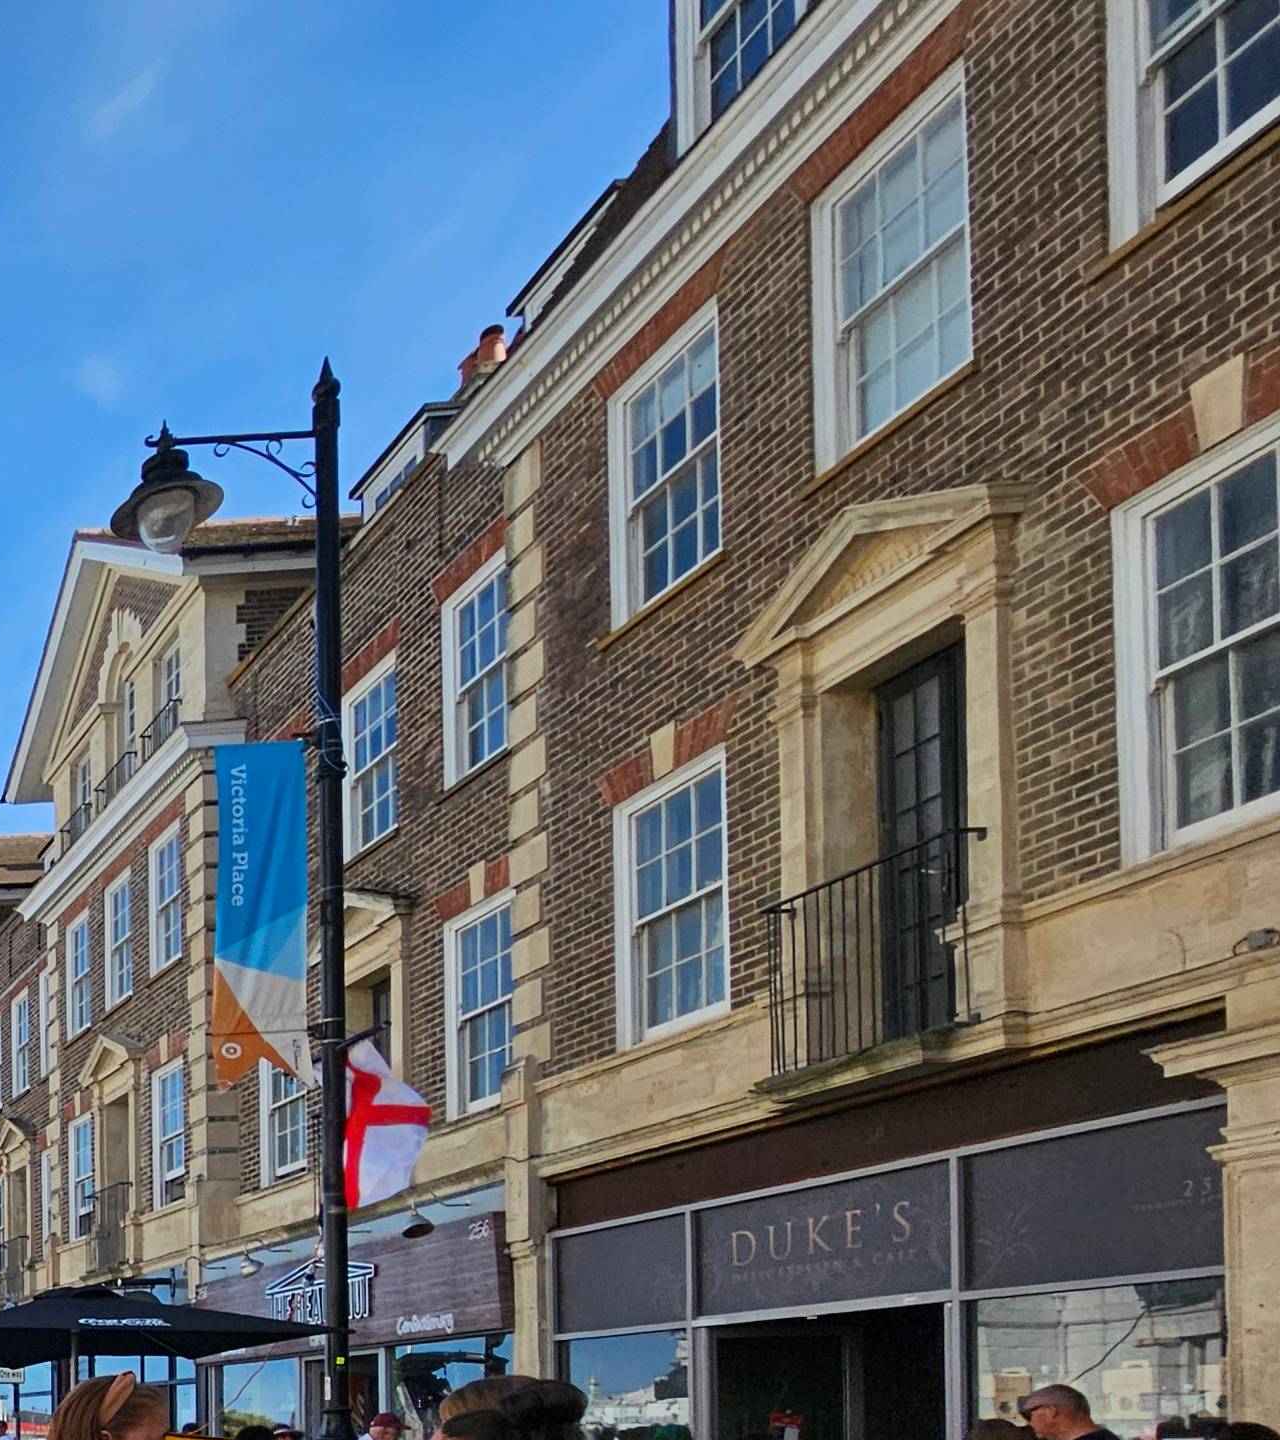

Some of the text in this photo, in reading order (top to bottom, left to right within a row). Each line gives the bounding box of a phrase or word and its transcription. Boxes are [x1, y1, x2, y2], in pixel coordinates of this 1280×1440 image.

[230, 764, 248, 906] Victoria Place
[730, 1201, 911, 1267] DUKE'S
